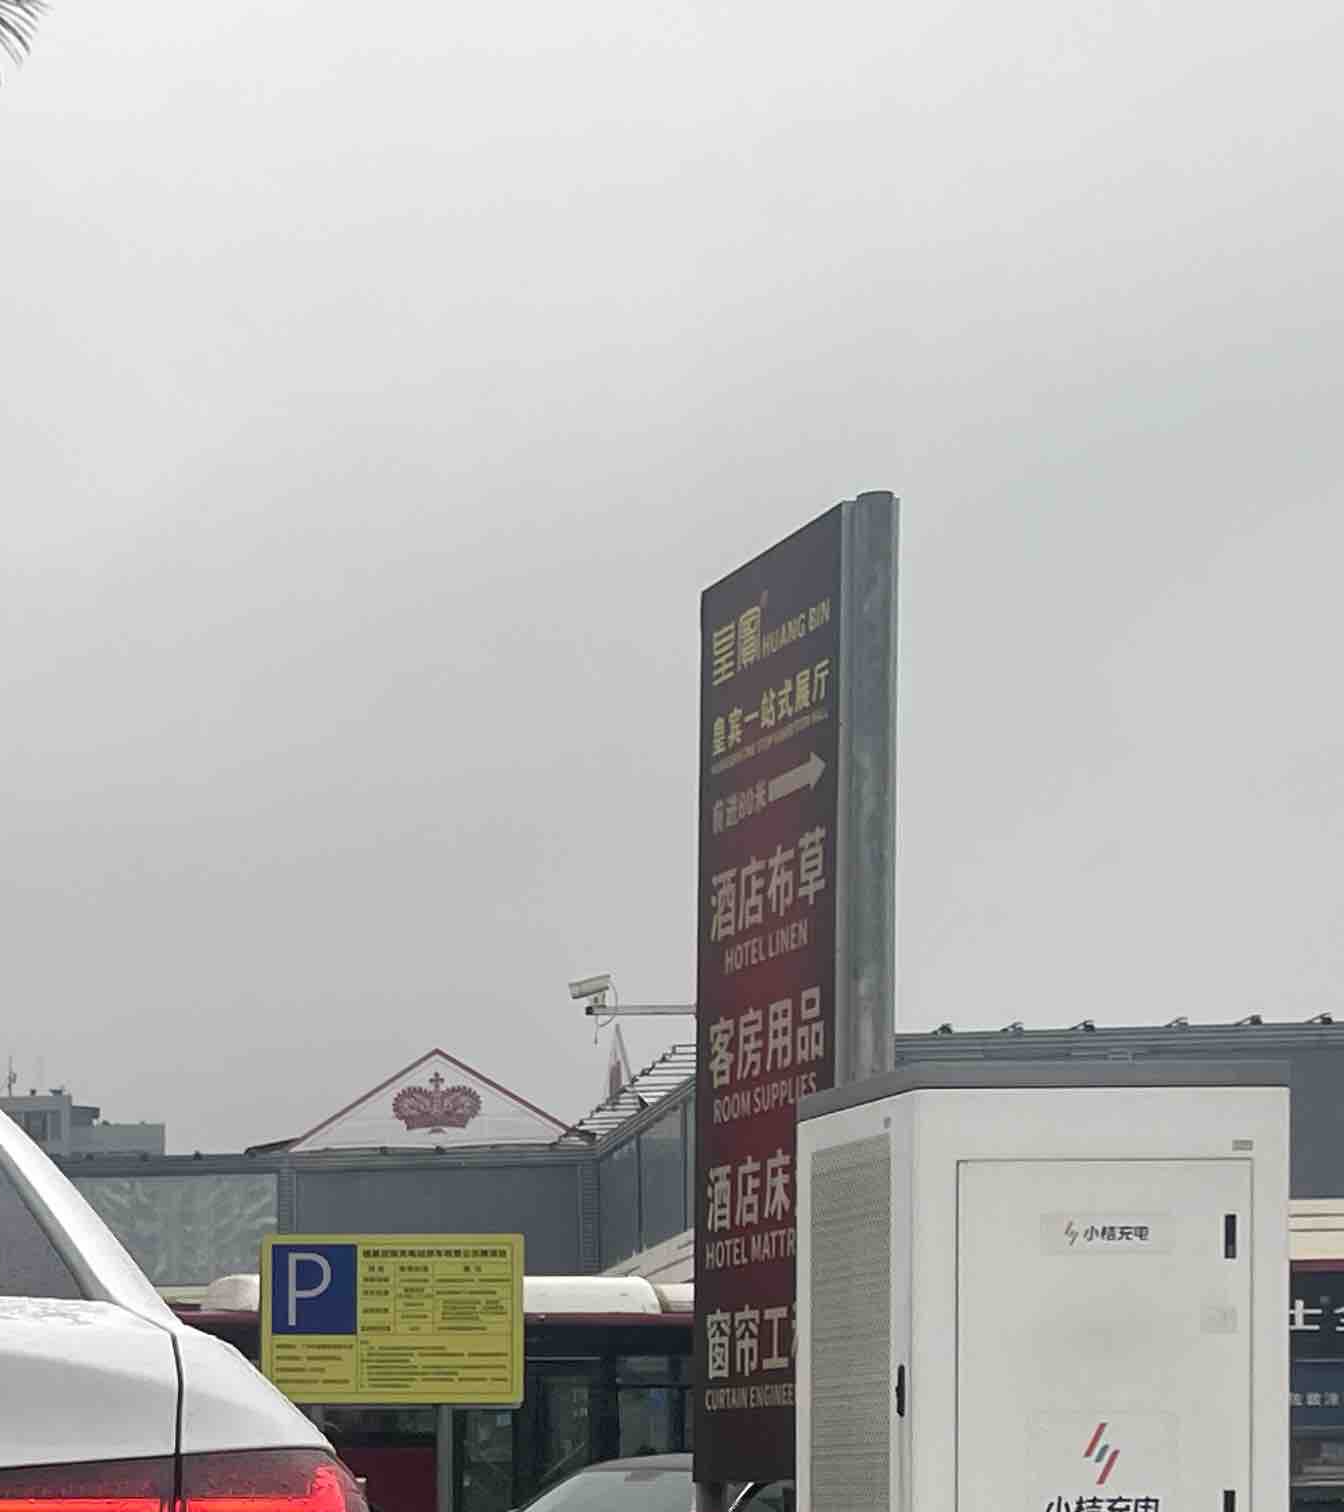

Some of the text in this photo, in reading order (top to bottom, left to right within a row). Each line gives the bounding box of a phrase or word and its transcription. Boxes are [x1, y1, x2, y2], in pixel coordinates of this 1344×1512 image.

[711, 826, 826, 941] 酒店布草
[725, 919, 808, 976] HOTEL LINEN
[709, 985, 825, 1089] 客房用品
[713, 1071, 817, 1125] ROOM SUPPLIES
[707, 1148, 797, 1233] 酒店床
[705, 1237, 749, 1270] HOTEL
[1083, 1225, 1150, 1242] 小桔充电
[288, 1251, 333, 1327] P
[707, 1304, 798, 1379] 窗帘工
